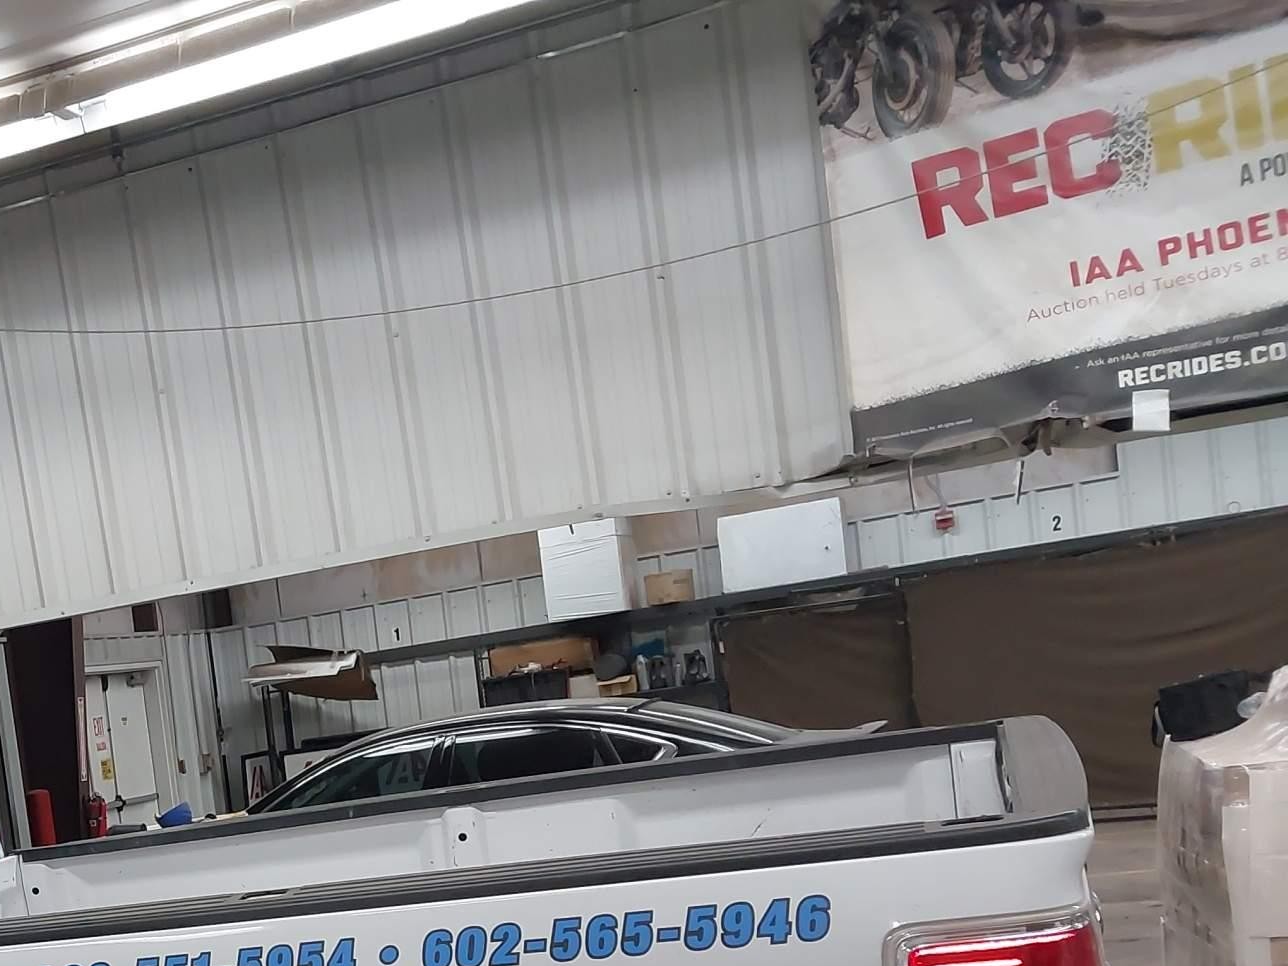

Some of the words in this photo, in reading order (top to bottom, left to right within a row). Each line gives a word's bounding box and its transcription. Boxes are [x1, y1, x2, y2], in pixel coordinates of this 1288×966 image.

[911, 108, 1123, 240] REC
[1240, 162, 1255, 187] A
[1259, 152, 1288, 181] PO
[1069, 248, 1144, 288] IAA
[1027, 294, 1100, 323] Auction
[1104, 280, 1146, 303] held
[1152, 260, 1244, 292] Tuesdays
[1249, 253, 1271, 268] at
[1086, 354, 1106, 368] Ask
[1118, 341, 1288, 389] RECRIDES.CO
[1052, 515, 1062, 531] 2
[393, 627, 400, 641] 1
